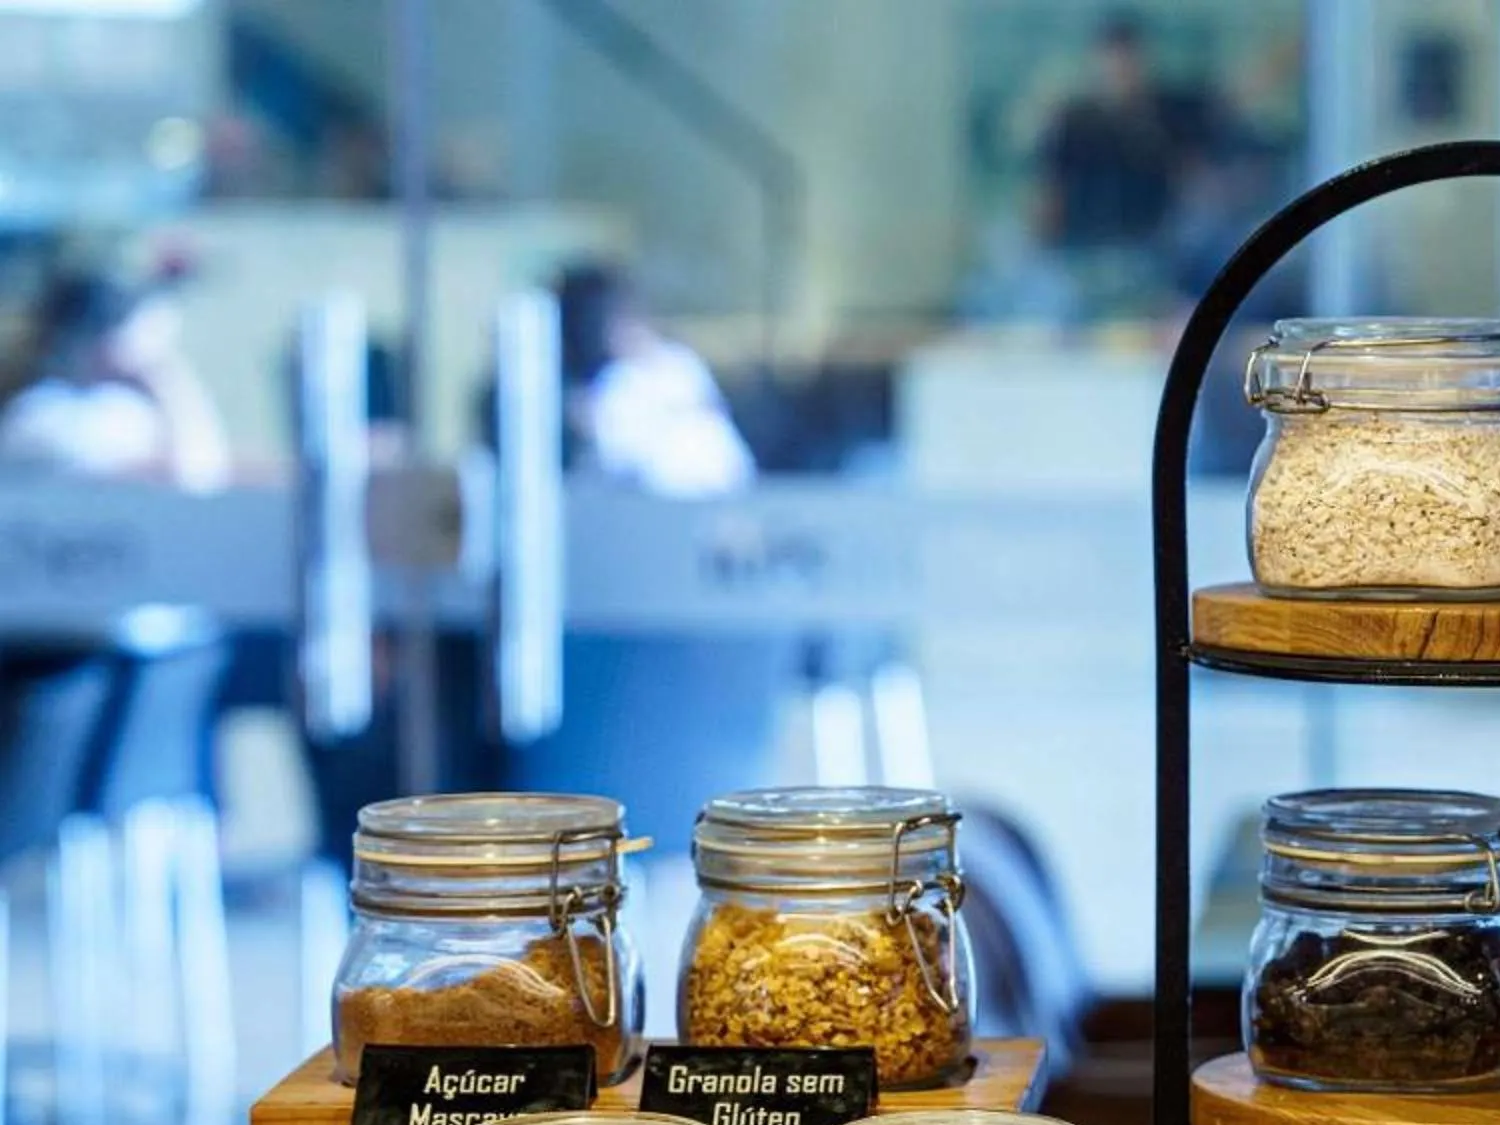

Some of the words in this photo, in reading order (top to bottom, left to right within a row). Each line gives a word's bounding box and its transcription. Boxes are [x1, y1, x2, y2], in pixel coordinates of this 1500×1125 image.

[423, 1064, 526, 1100] Açúcar
[667, 1065, 777, 1094] Granola
[785, 1073, 845, 1094] sem
